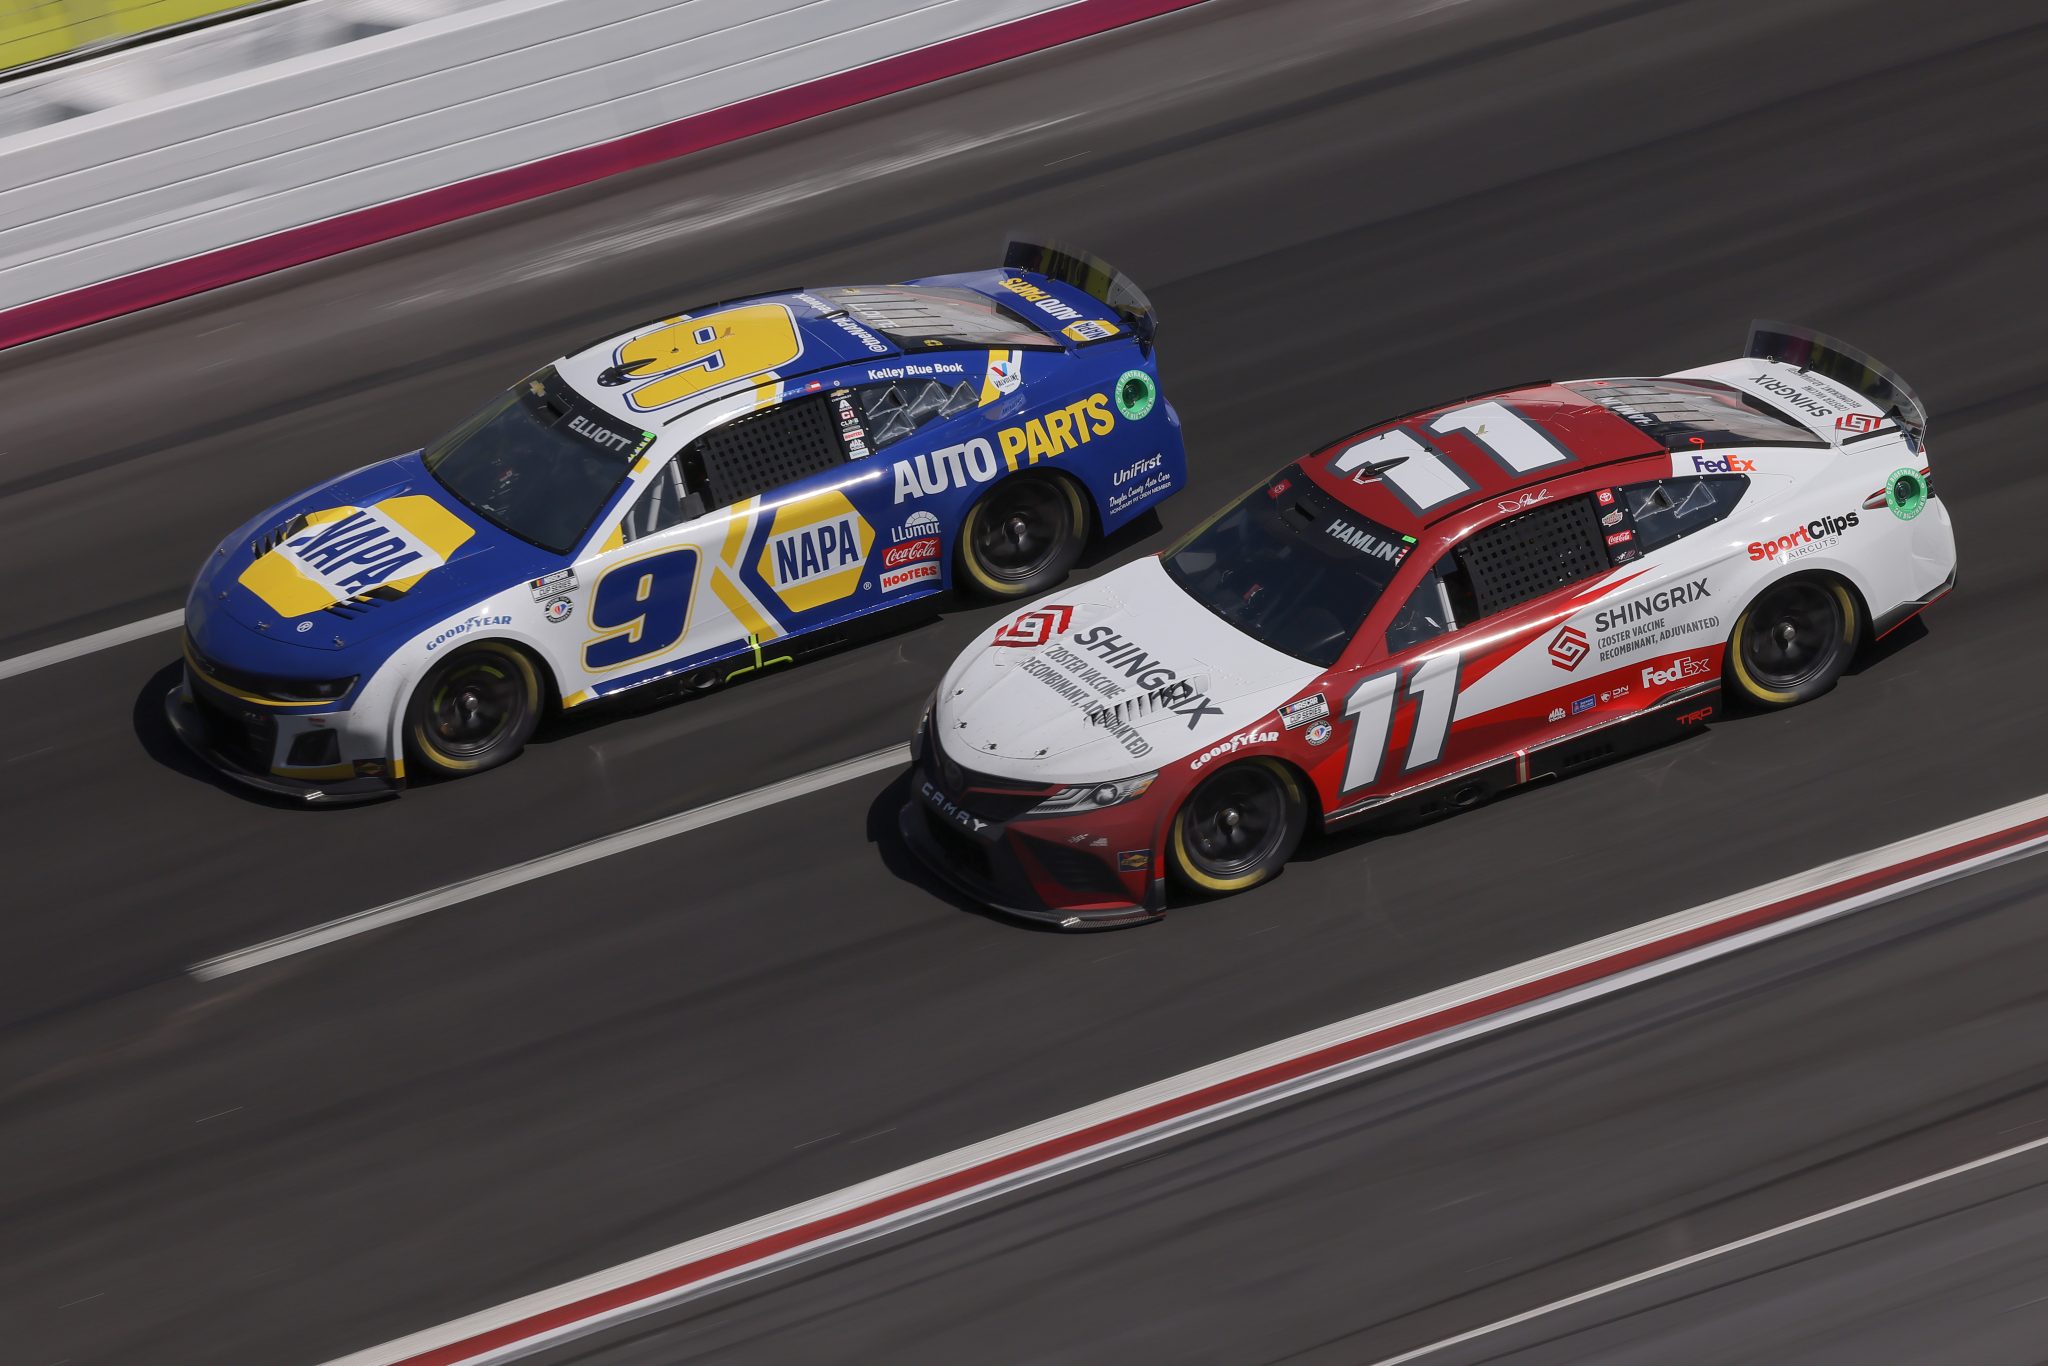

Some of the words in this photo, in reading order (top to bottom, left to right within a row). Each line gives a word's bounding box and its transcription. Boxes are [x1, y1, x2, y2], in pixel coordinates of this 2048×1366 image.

[999, 278, 1052, 302] PARTS
[1035, 299, 1083, 320] AUTO
[1073, 321, 1109, 339] NAPA
[613, 303, 804, 413] 9
[868, 368, 904, 380] Kelley
[906, 365, 933, 375] Blue
[934, 363, 964, 373] Book
[1749, 374, 1832, 417] SHINGRIX
[568, 415, 631, 452] ELLIOTT
[894, 437, 997, 505] AUTO
[998, 393, 1115, 472] PARTS
[1113, 453, 1162, 486] UniFirst
[1326, 398, 1577, 516] 11
[1692, 455, 1757, 473] FedEx
[891, 522, 940, 542] LLumar
[1326, 519, 1398, 562] HAMLIN
[287, 512, 422, 593] NAPA
[775, 520, 860, 584] NAPA
[886, 540, 937, 566] Coca-Cola
[883, 566, 936, 588] HOOTERS
[581, 543, 702, 673] 9
[1595, 577, 1711, 632] SHINGRIX
[426, 615, 512, 651] GOODYEAR
[1598, 630, 1631, 650] (ZOSTER
[1632, 618, 1665, 636] VACCINE
[1600, 634, 1659, 661] RECOMBINANT,
[1660, 616, 1719, 641] ADJUVANTED)
[1074, 626, 1224, 730] SHINGRIX
[1078, 666, 1126, 700] VACCINE
[1642, 657, 1711, 689] FedEx
[1339, 650, 1461, 796] 11
[1676, 706, 1713, 725] TRD
[1190, 731, 1279, 770] GOODYEAR
[921, 782, 988, 831] CAMRY
